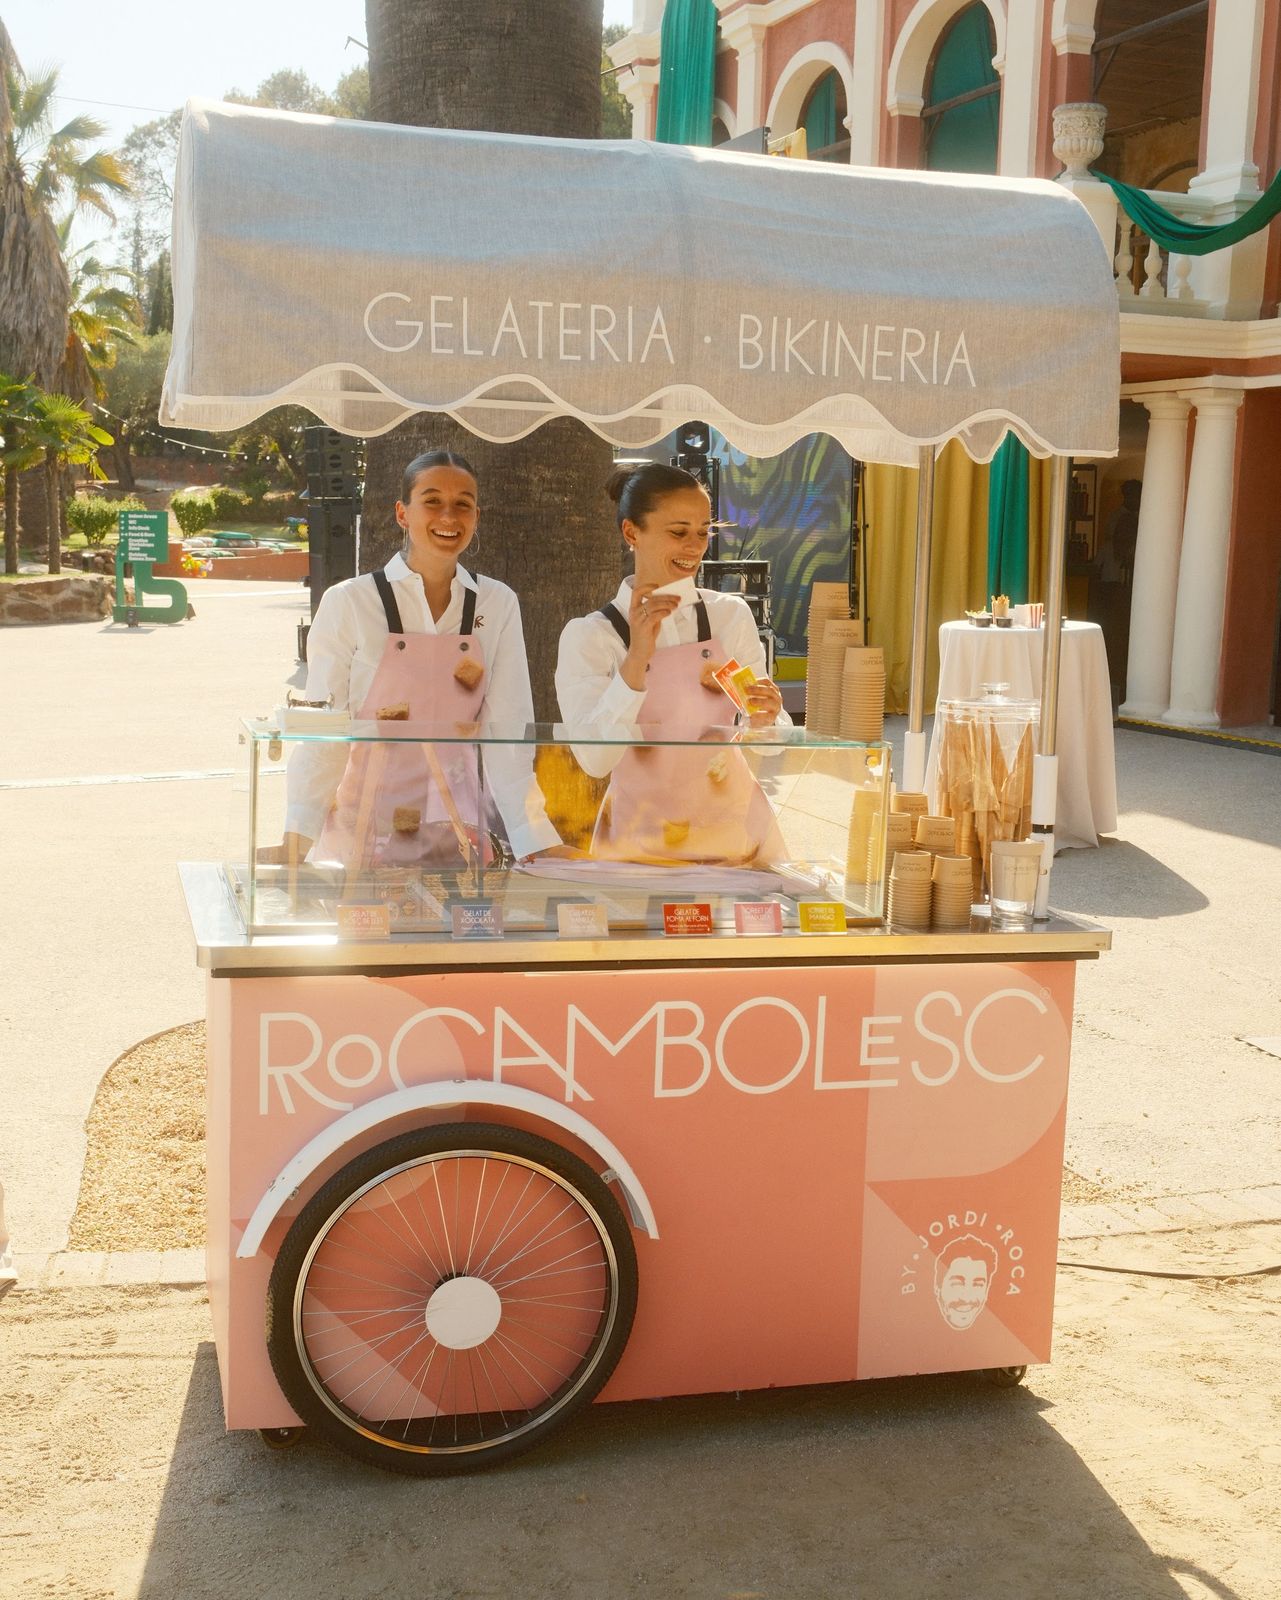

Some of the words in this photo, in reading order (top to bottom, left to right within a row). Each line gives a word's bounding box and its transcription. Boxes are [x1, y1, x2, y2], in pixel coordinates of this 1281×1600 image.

[363, 291, 675, 364] GELATERIA
[739, 312, 976, 388] BIKINERIA
[901, 1265, 917, 1296] BY
[918, 1210, 988, 1249] JORDI
[1000, 1228, 1025, 1296] ROCA
